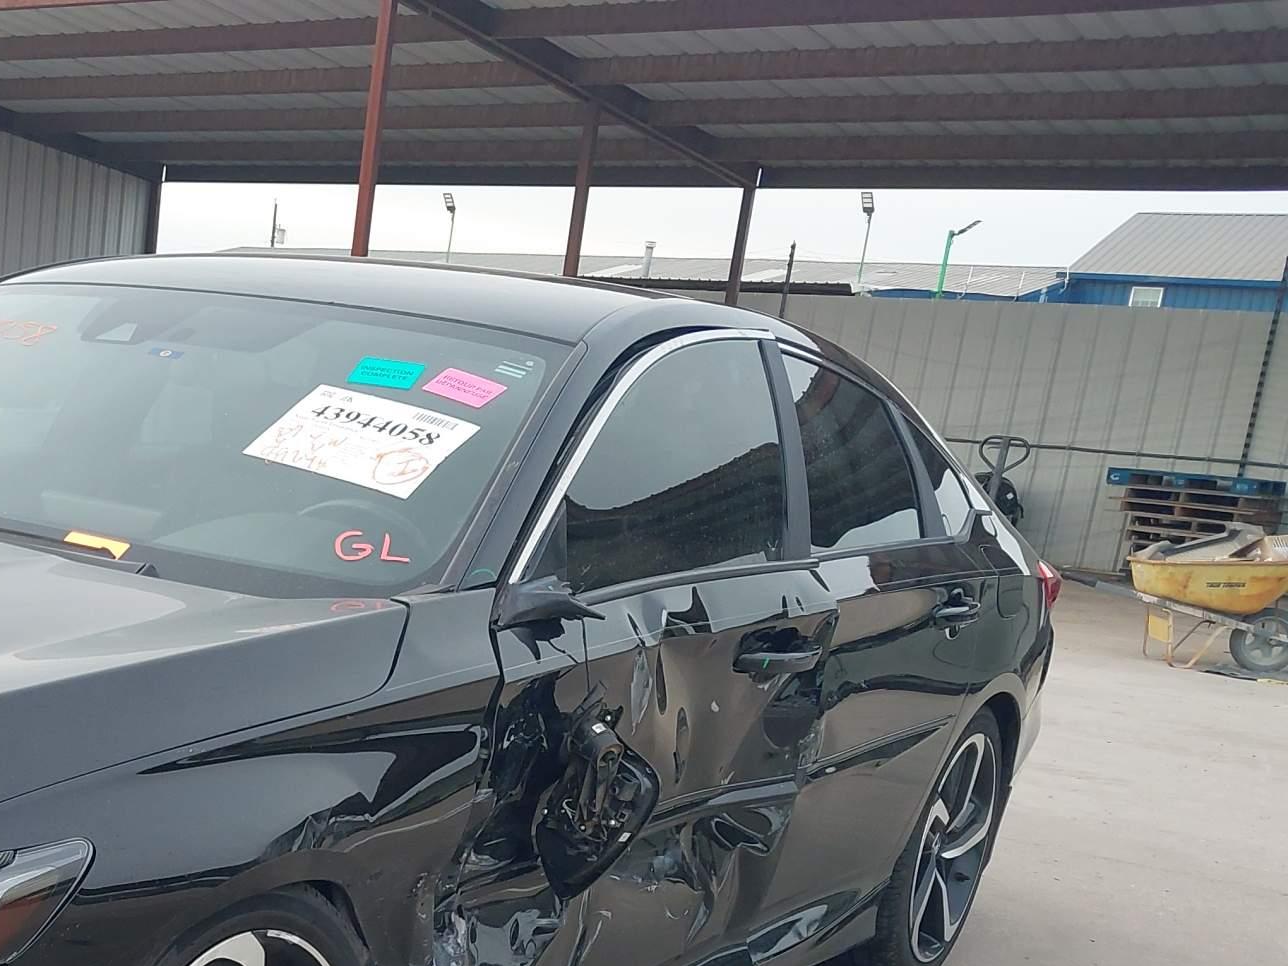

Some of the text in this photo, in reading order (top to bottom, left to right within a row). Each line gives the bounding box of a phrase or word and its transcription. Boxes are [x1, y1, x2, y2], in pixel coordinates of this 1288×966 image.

[360, 365, 415, 376] INSPECTION
[361, 371, 407, 380] COMPLETE
[312, 405, 440, 446] 43944058
[334, 529, 411, 563] GL
